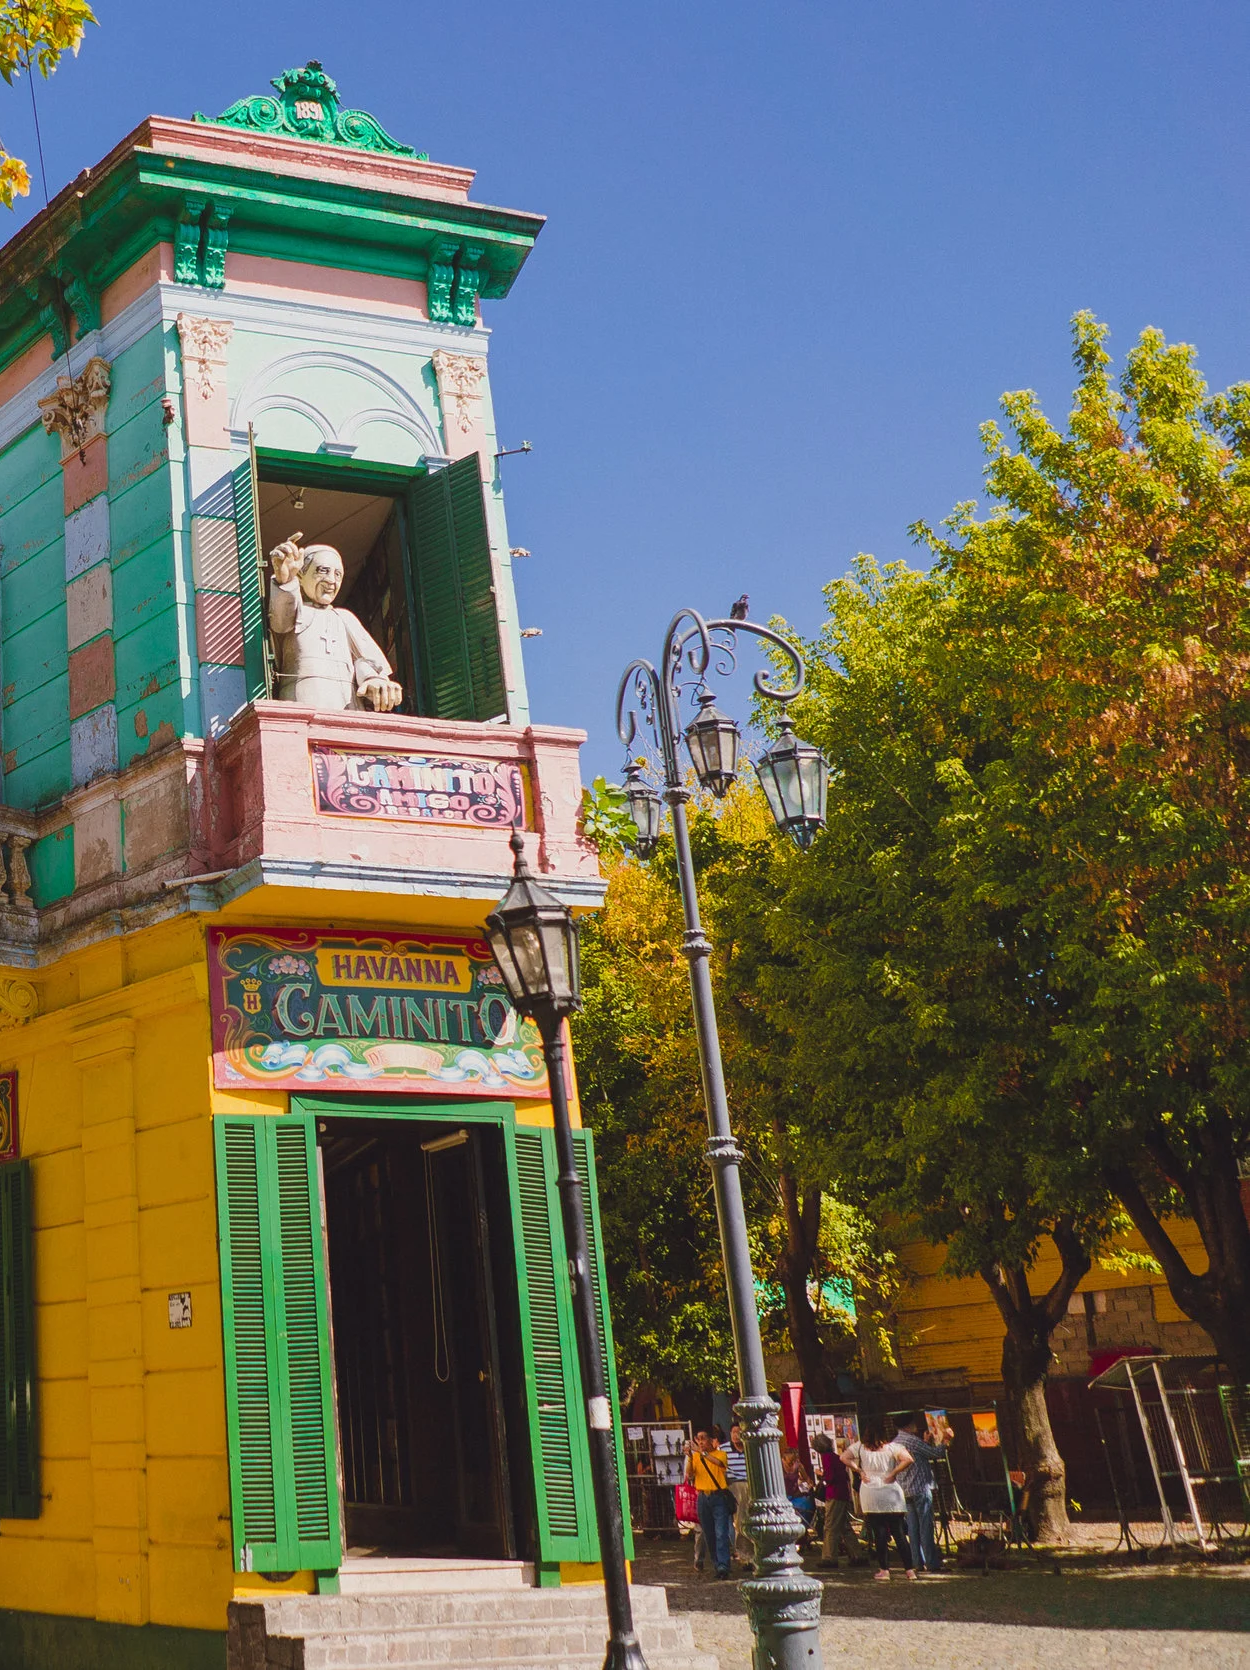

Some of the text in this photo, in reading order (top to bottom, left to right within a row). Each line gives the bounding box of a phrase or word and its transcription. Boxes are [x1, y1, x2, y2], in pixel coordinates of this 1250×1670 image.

[295, 101, 324, 121] 1891
[347, 756, 496, 795] CAMINITO
[377, 788, 470, 810] AMIGO
[385, 806, 464, 820] REGALOS
[333, 954, 461, 985] HAVANNA
[246, 994, 259, 1010] H
[275, 983, 517, 1047] CAMINITO
